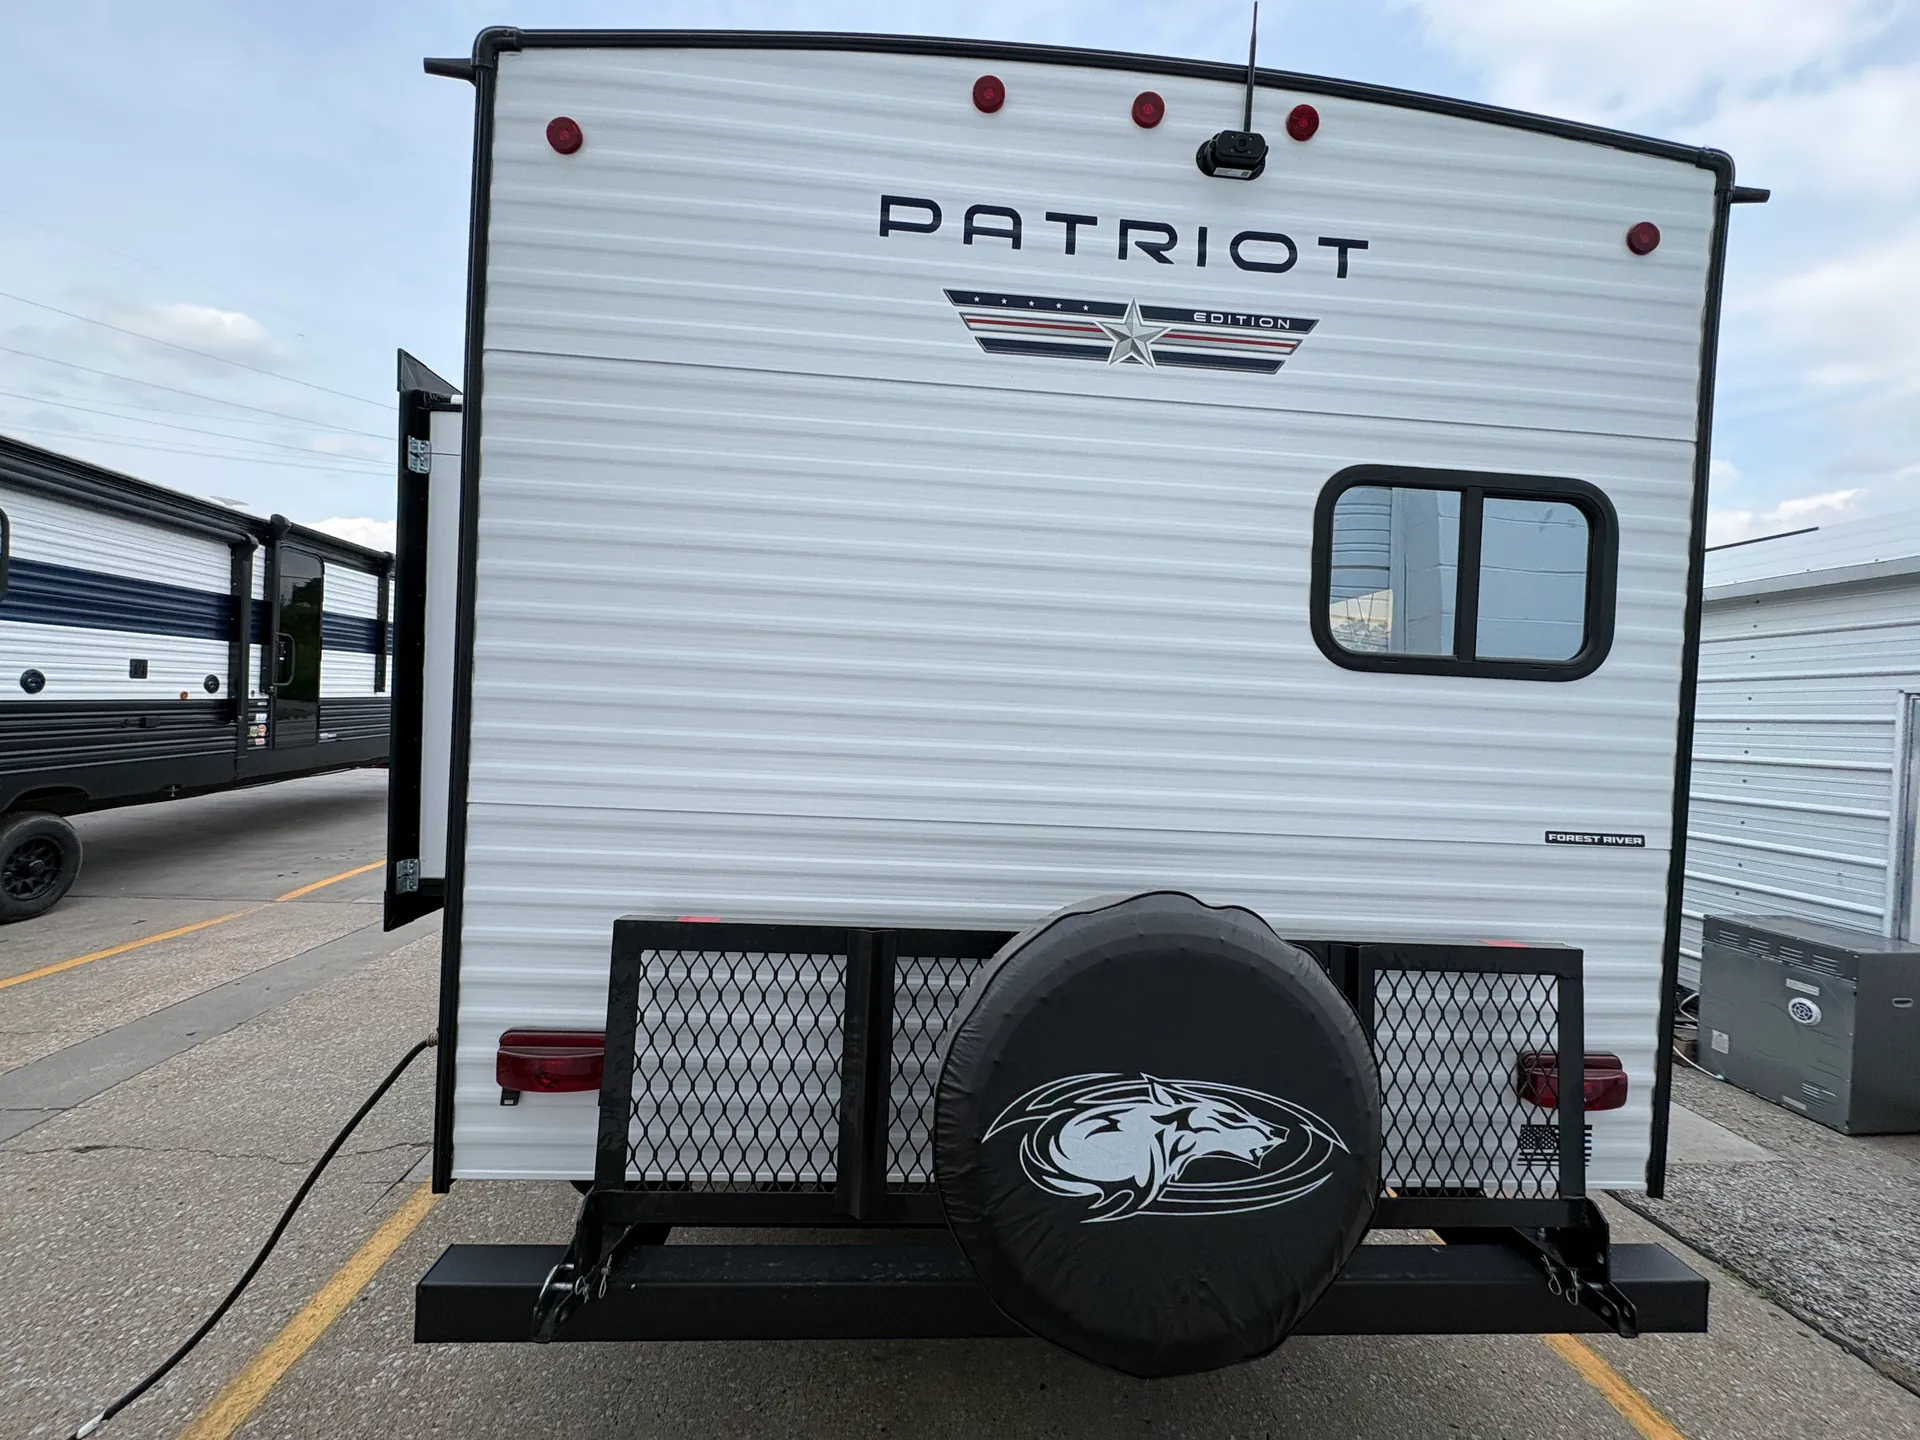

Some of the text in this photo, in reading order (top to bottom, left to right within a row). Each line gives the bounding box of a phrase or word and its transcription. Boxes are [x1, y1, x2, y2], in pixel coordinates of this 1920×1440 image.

[879, 194, 1369, 279] PATRIOT
[1193, 312, 1290, 329] EDITION
[1548, 833, 1643, 845] FOREST RIVER
